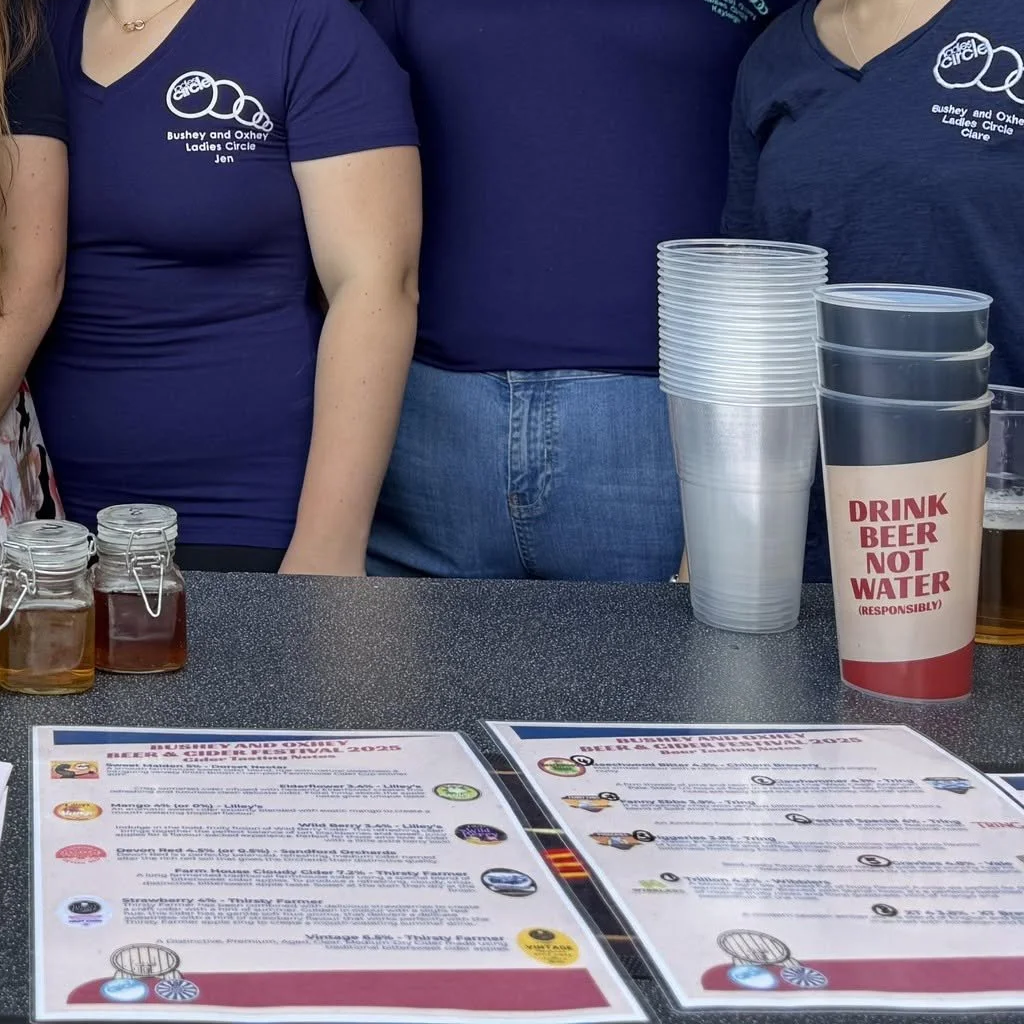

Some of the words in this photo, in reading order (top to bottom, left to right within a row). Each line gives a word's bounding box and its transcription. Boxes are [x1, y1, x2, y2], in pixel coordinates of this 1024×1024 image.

[940, 38, 988, 69] circle
[172, 77, 212, 101] circle
[932, 104, 968, 117] Bushey
[972, 109, 992, 119] and
[996, 111, 1024, 126] Oxhe
[942, 114, 977, 128] Ladies
[982, 120, 1014, 136] Circle
[167, 130, 206, 141] Bushey
[209, 130, 231, 140] and
[234, 130, 269, 141] Oxhey
[960, 128, 991, 142] Clare
[185, 141, 222, 152] Ladies
[225, 141, 256, 151] Circle
[214, 154, 234, 164] Jen
[849, 492, 948, 522] DRINK
[859, 521, 938, 549] BEER
[866, 548, 929, 574] NOT
[850, 570, 951, 600] WATER
[858, 599, 943, 616] (RESPONSIBLY)
[251, 748, 344, 756] FESTIVAL
[717, 740, 805, 749] FESTIVAL
